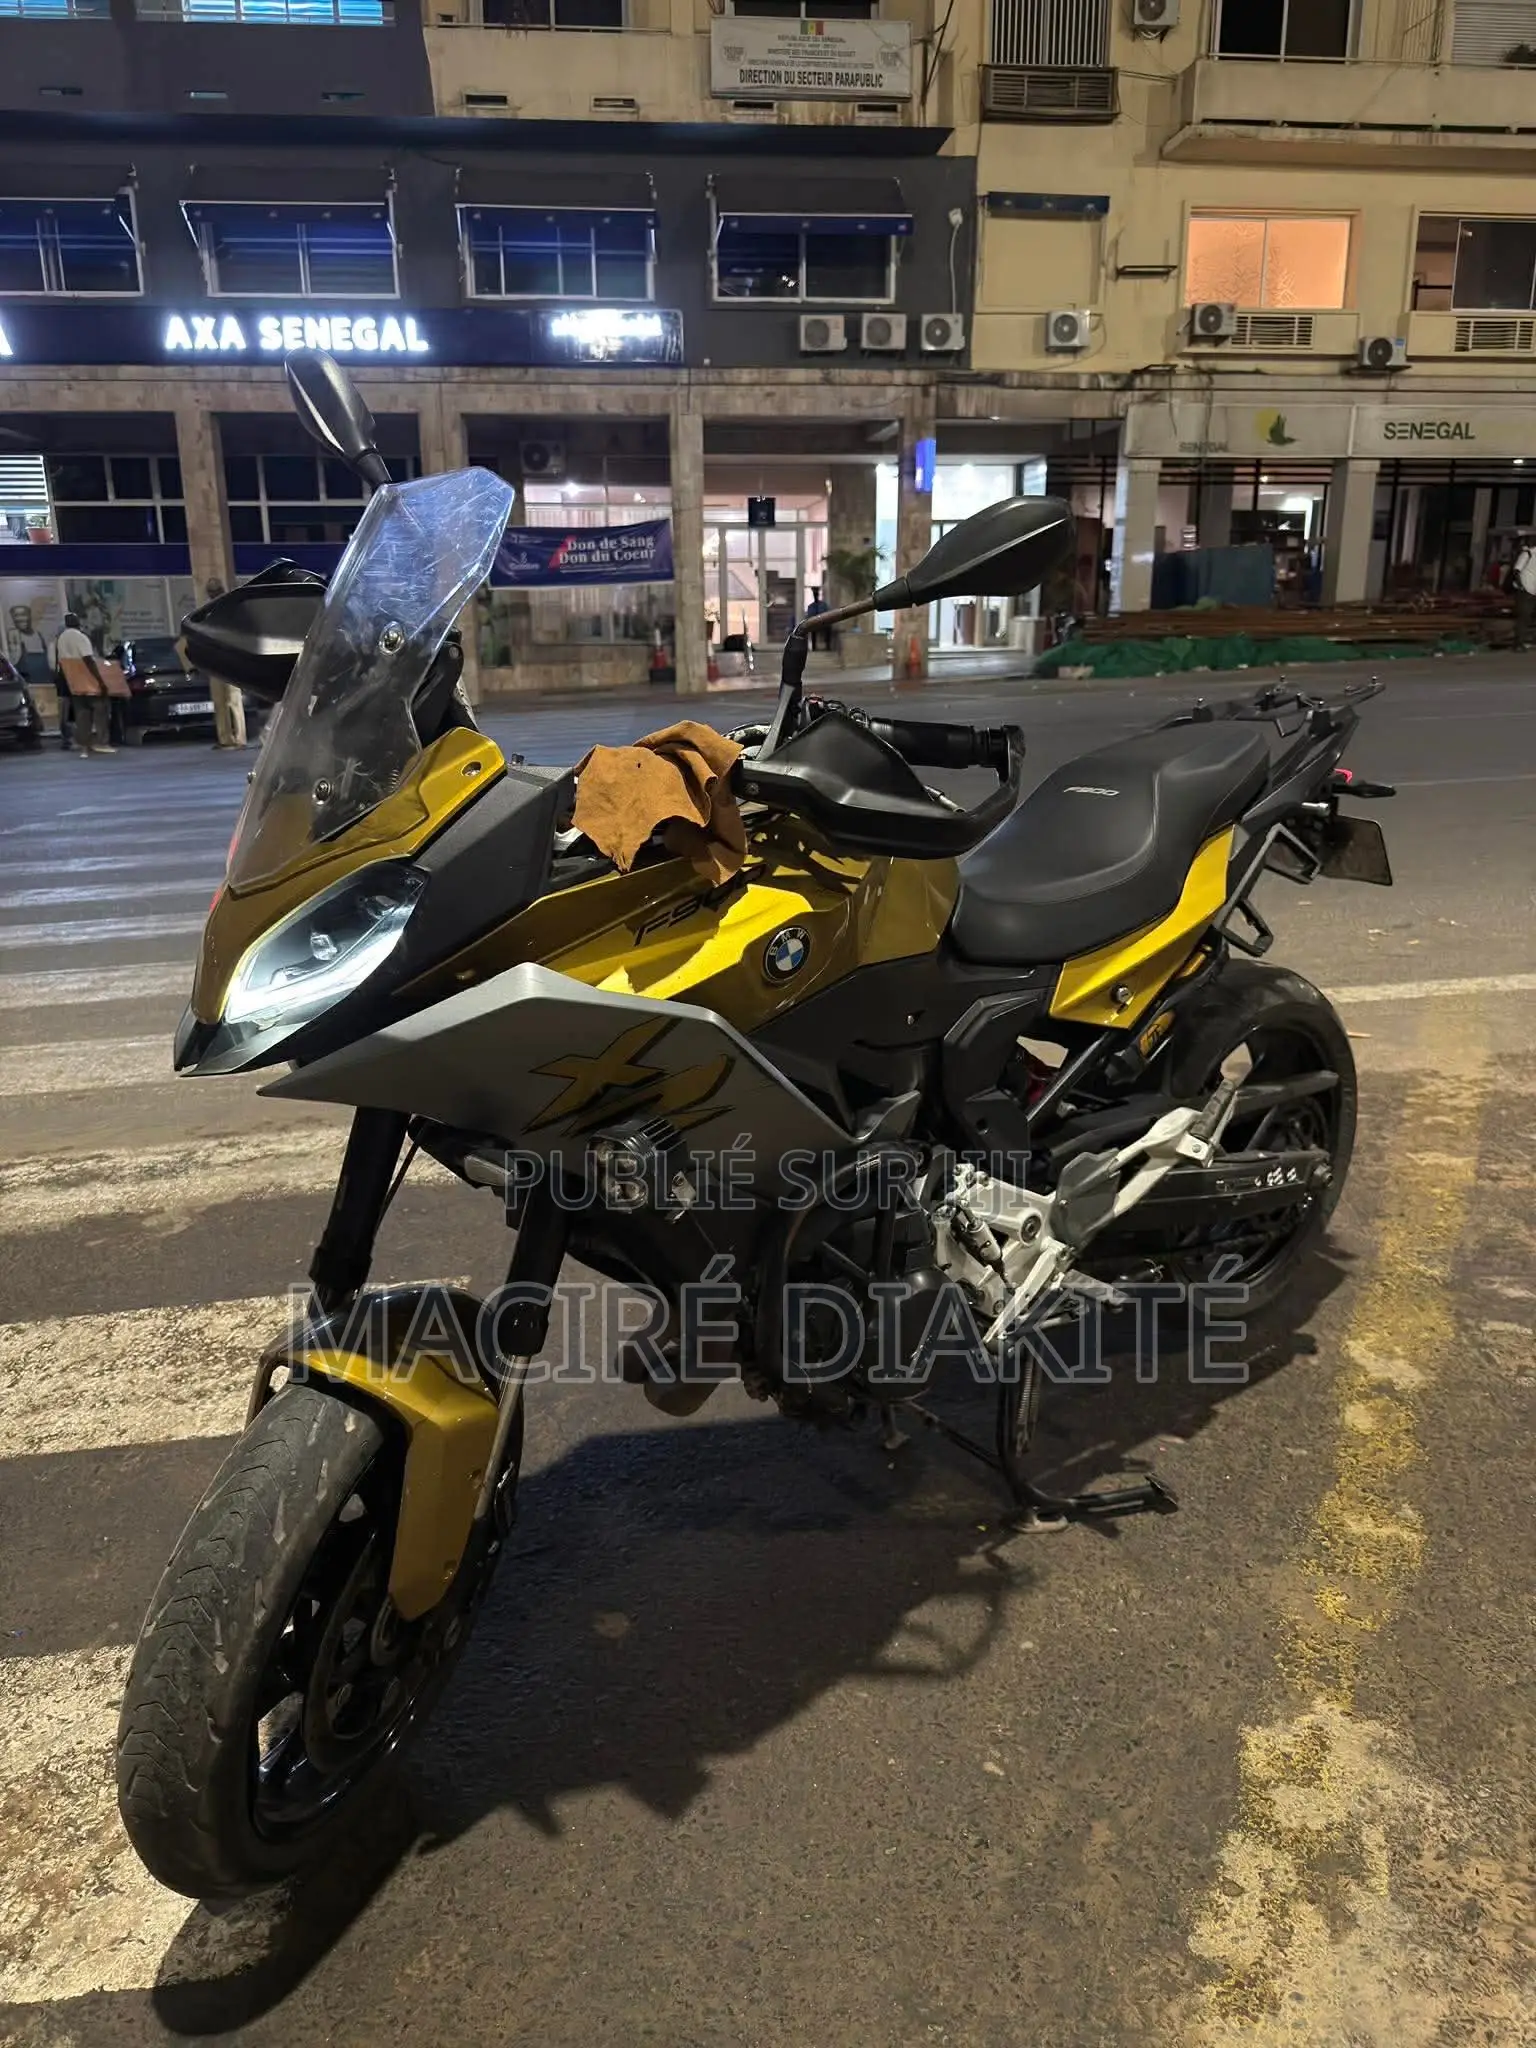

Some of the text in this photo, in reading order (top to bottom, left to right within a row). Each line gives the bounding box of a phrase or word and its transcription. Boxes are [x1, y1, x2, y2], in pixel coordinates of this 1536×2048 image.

[739, 69, 884, 89] DIRECTION DU SECTEUR PARAPUBLIC
[165, 315, 429, 351] AXA SENEGAL
[1383, 421, 1476, 440] SENEGAL
[567, 535, 655, 551] Don de Sang
[559, 551, 588, 564] Don
[591, 549, 611, 563] du
